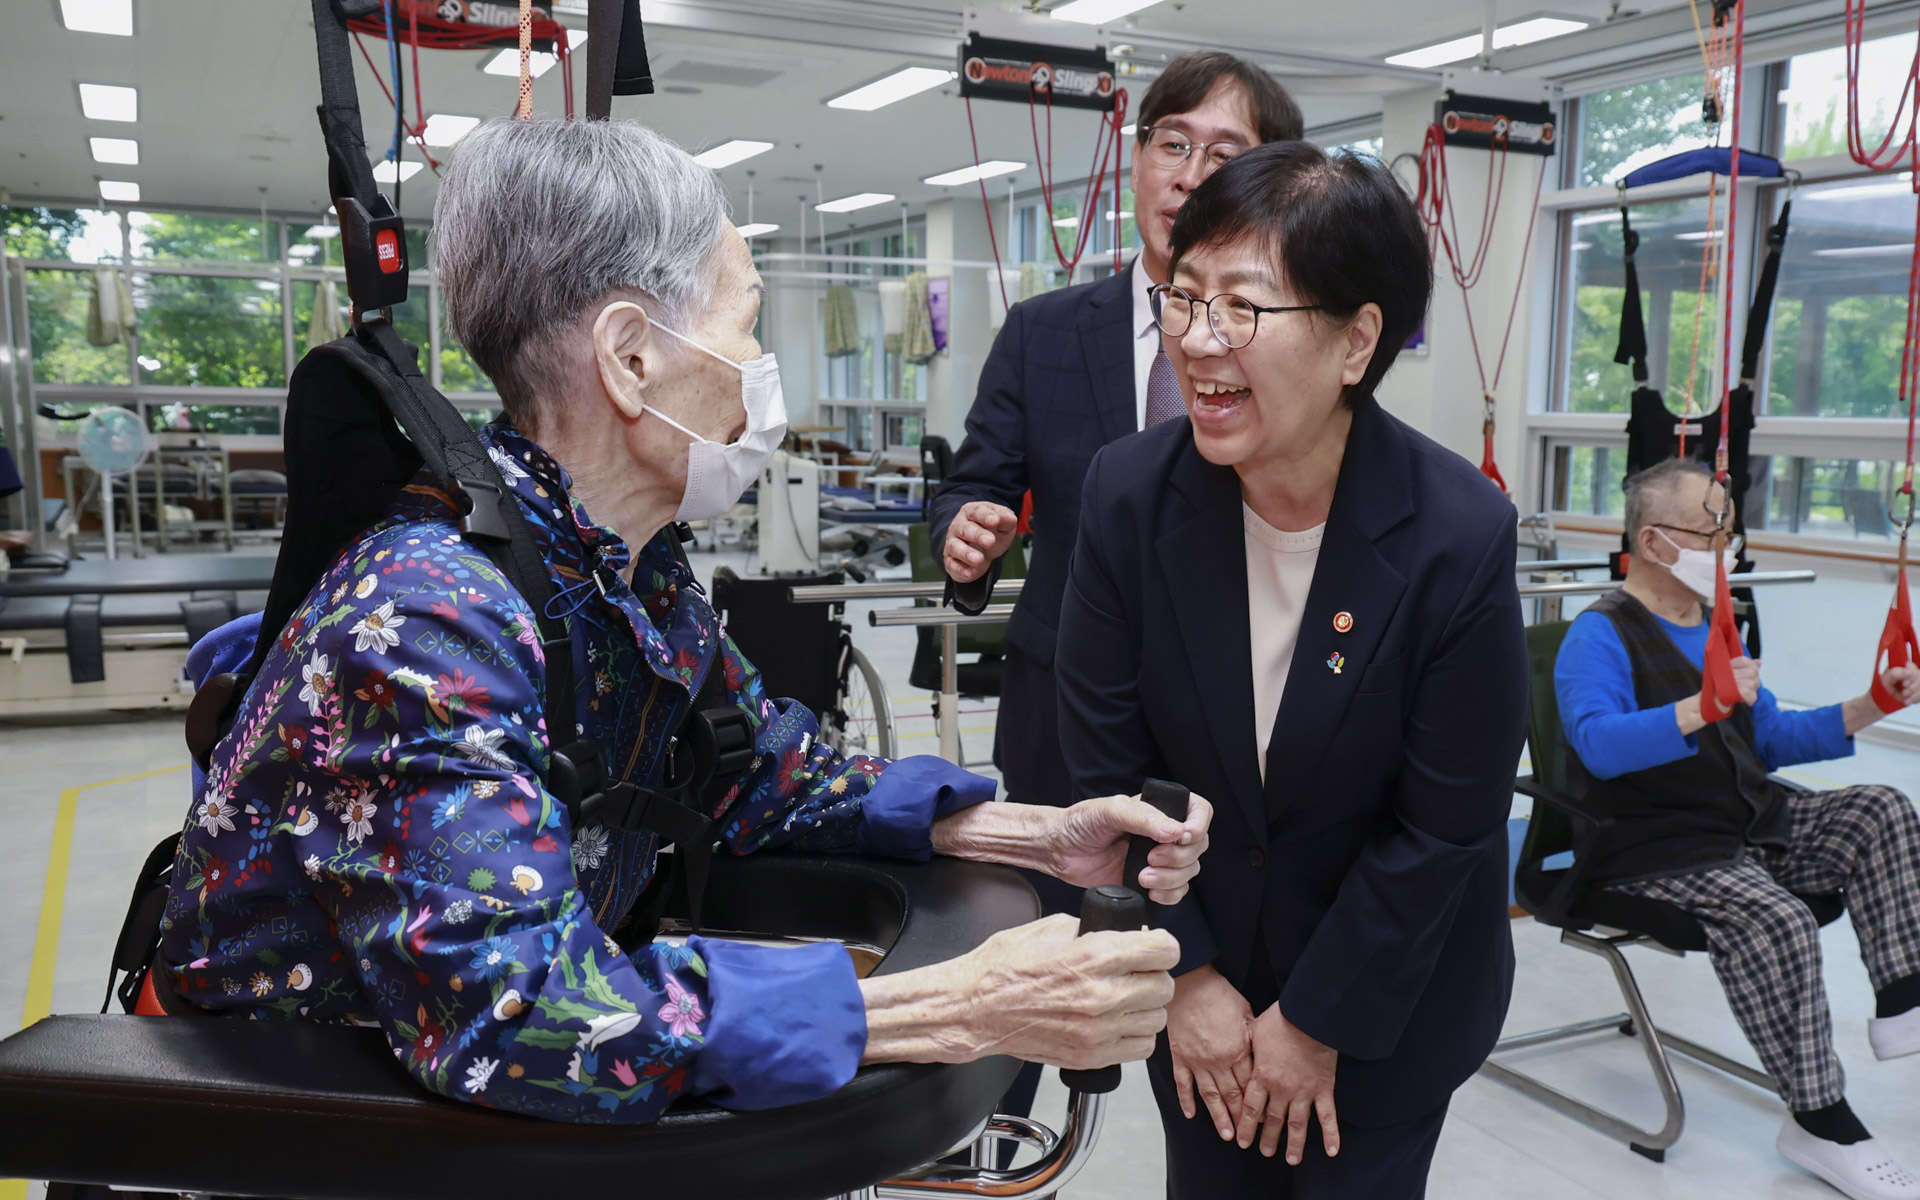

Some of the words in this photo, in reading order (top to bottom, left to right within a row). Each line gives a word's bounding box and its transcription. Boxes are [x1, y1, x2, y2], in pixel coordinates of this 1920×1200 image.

[968, 61, 1031, 84] Newton
[1054, 69, 1095, 96] Sling
[379, 243, 395, 260] PRESS
